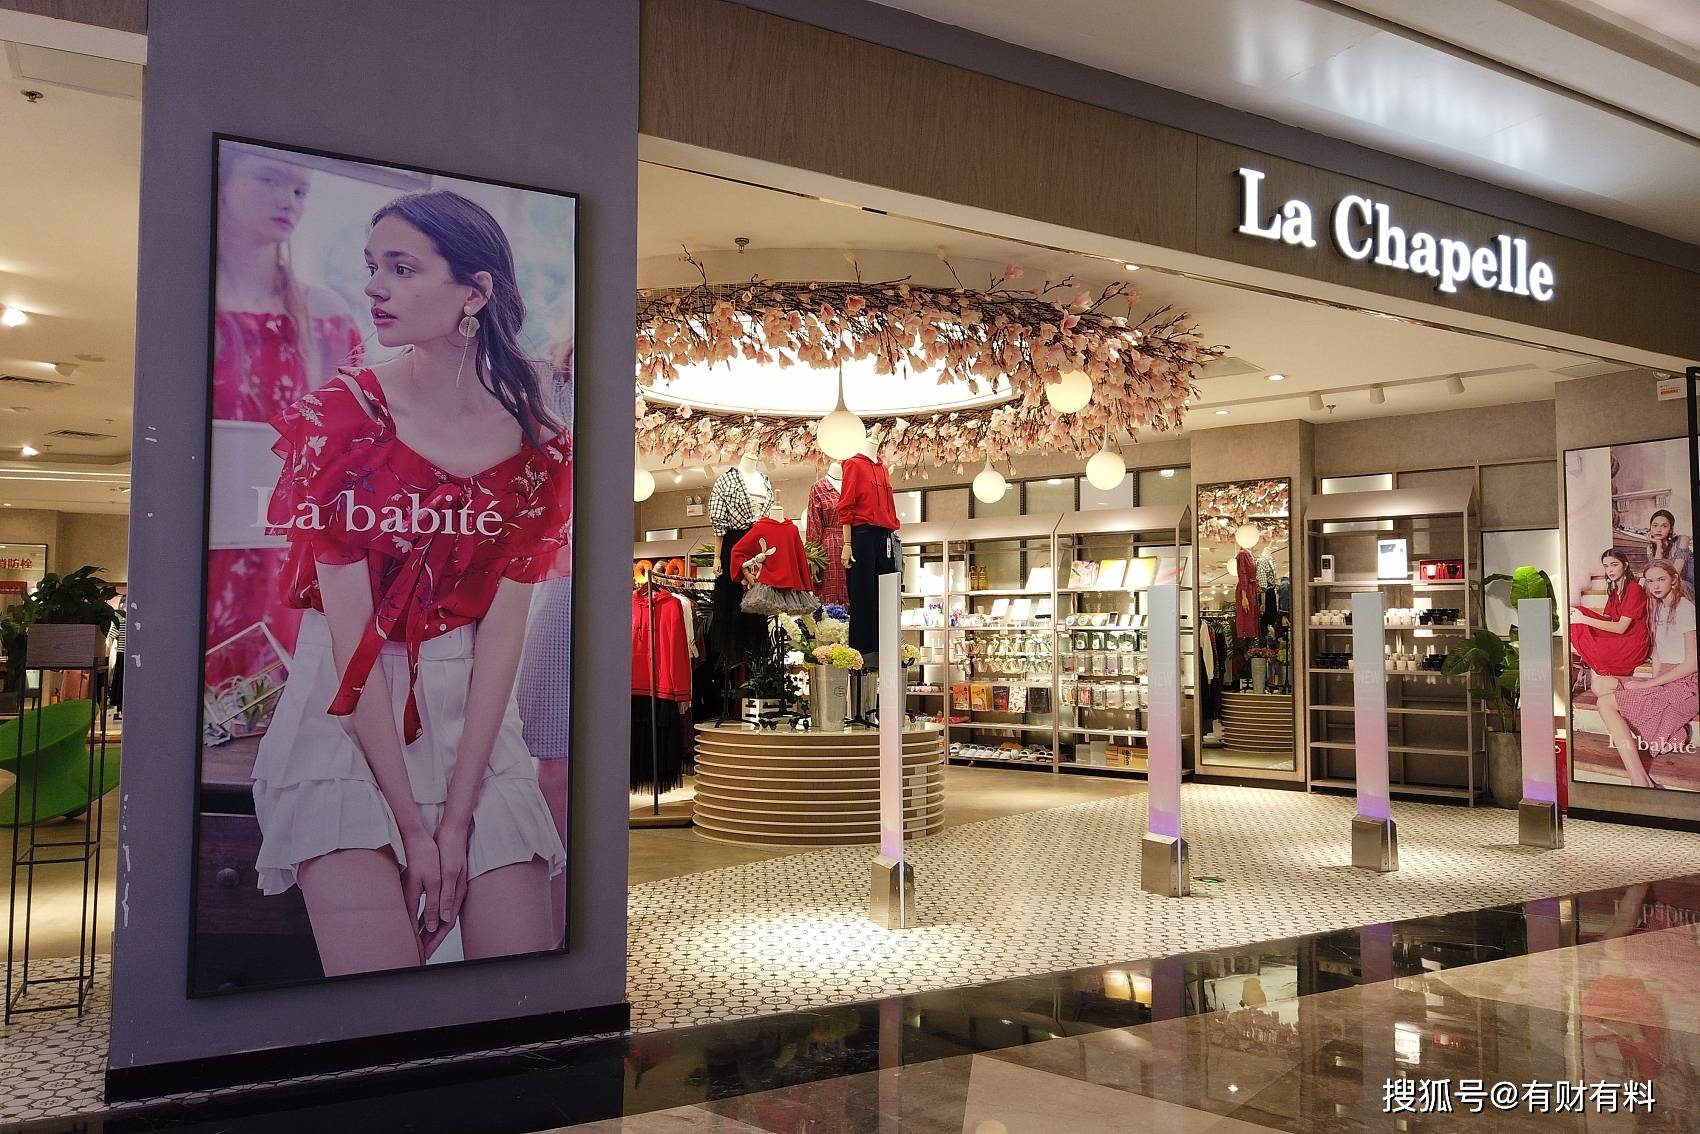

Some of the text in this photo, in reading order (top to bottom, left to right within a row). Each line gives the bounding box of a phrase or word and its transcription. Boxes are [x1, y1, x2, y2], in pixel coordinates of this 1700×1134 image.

[1238, 167, 1554, 301] La Chapelle
[251, 486, 503, 536] La babité
